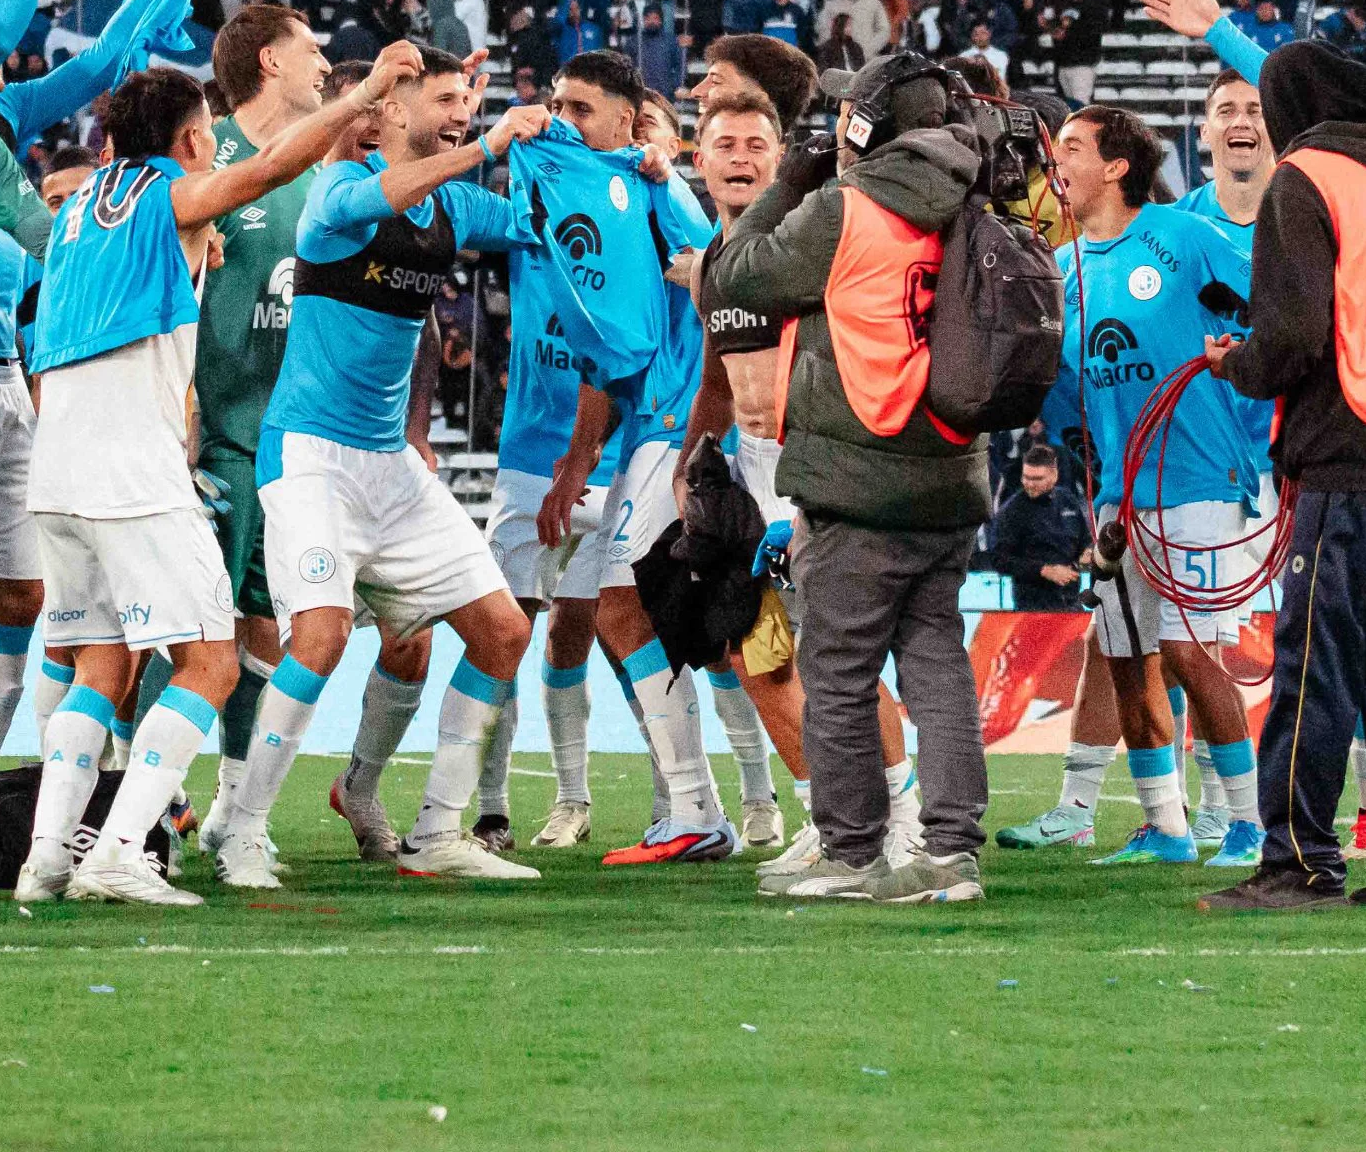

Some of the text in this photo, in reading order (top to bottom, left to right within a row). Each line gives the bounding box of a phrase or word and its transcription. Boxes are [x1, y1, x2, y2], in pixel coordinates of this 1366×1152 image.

[852, 123, 867, 138] 07
[212, 138, 238, 170] ANOS
[1139, 230, 1181, 273] SANOS
[1084, 362, 1154, 391] Macro
[1186, 549, 1217, 593] 51
